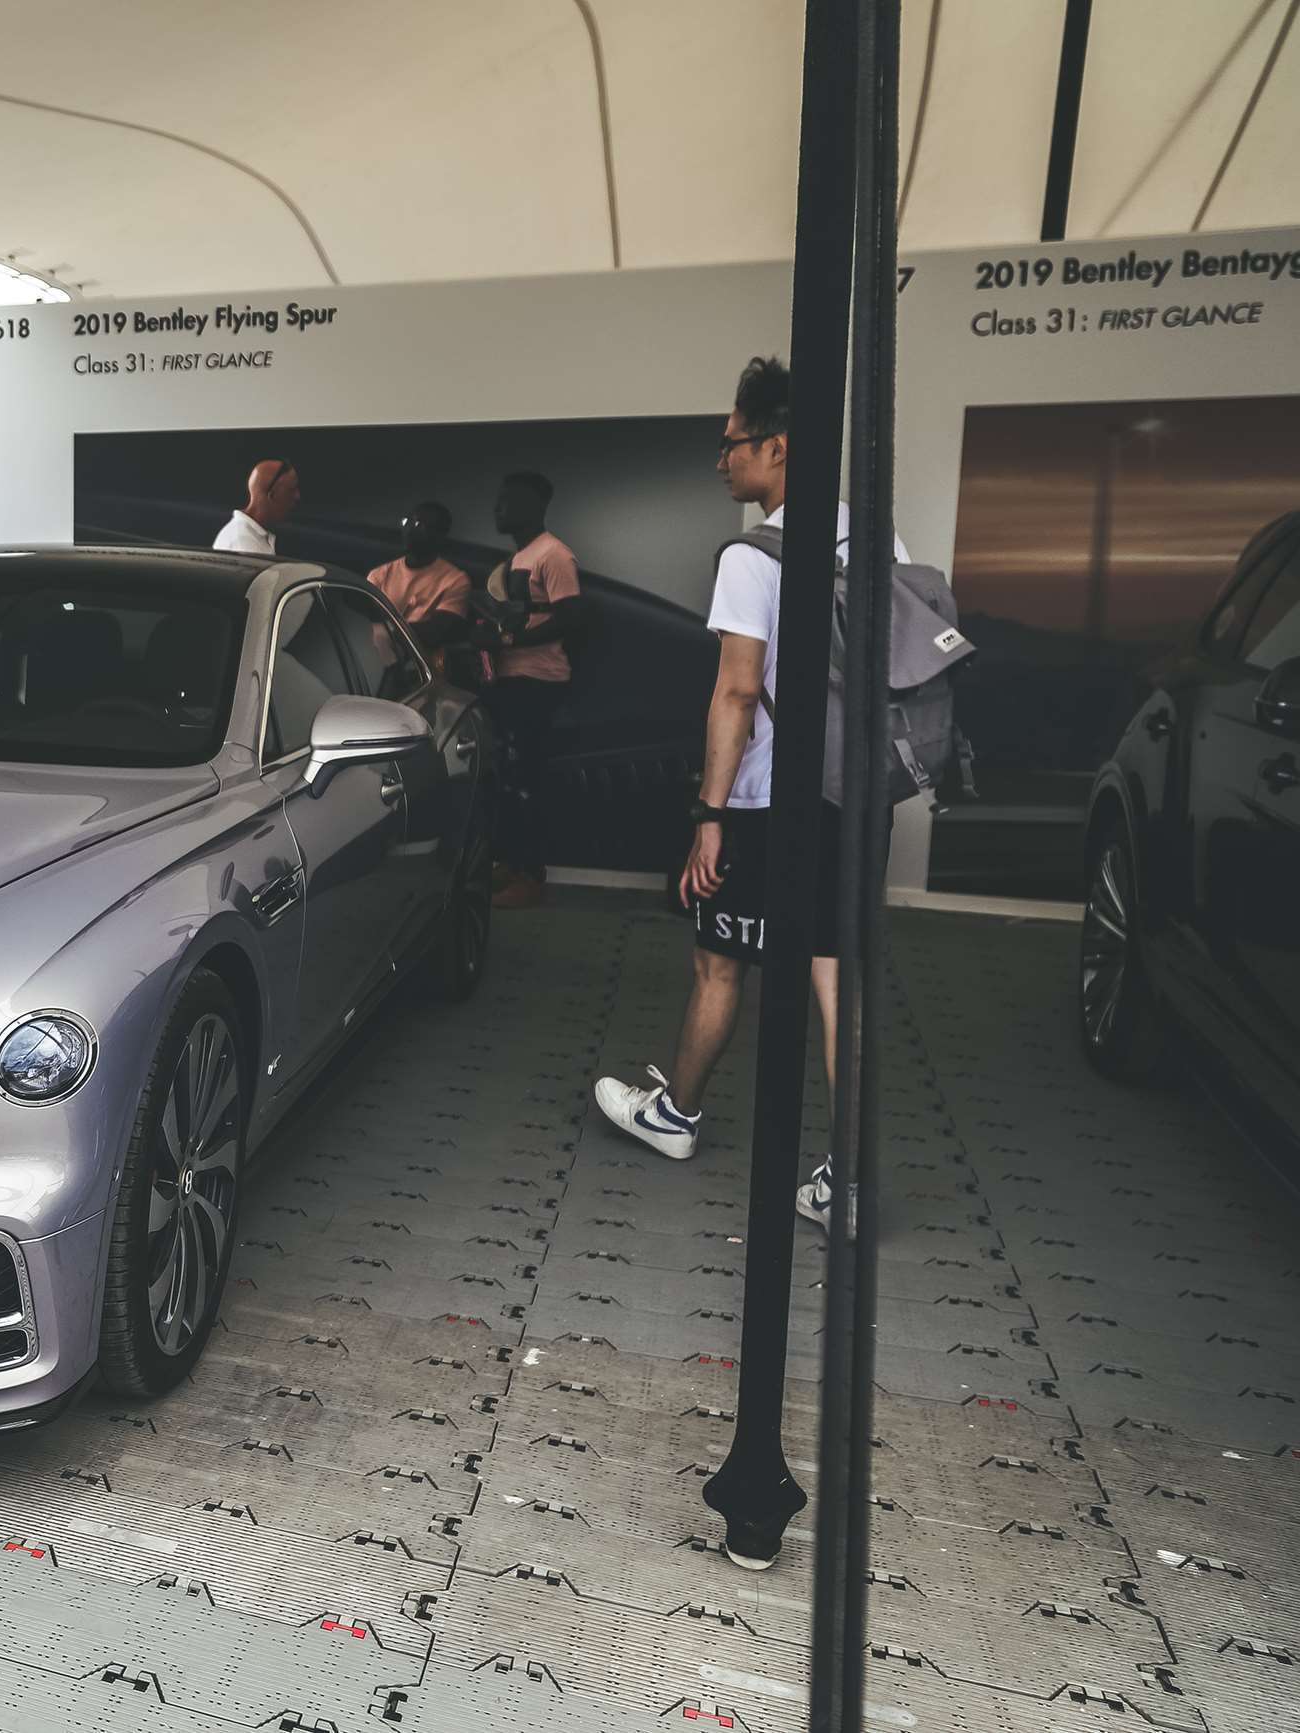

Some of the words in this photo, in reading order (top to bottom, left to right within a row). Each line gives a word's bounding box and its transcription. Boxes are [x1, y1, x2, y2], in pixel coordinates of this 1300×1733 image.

[975, 257, 1054, 290] 2019
[1061, 249, 1174, 288] Bentley
[72, 312, 128, 336] 2019
[133, 307, 210, 337] Bentley
[215, 303, 279, 335] Flying
[286, 302, 338, 332] Spur
[970, 308, 1037, 337] Class
[1045, 307, 1089, 333] 31:
[1098, 306, 1159, 331] FIRST
[1161, 302, 1265, 329] GLANCE
[73, 353, 120, 376] Class
[125, 352, 155, 374] 31:
[161, 352, 202, 371] FIRST
[205, 350, 274, 370] GLANCE
